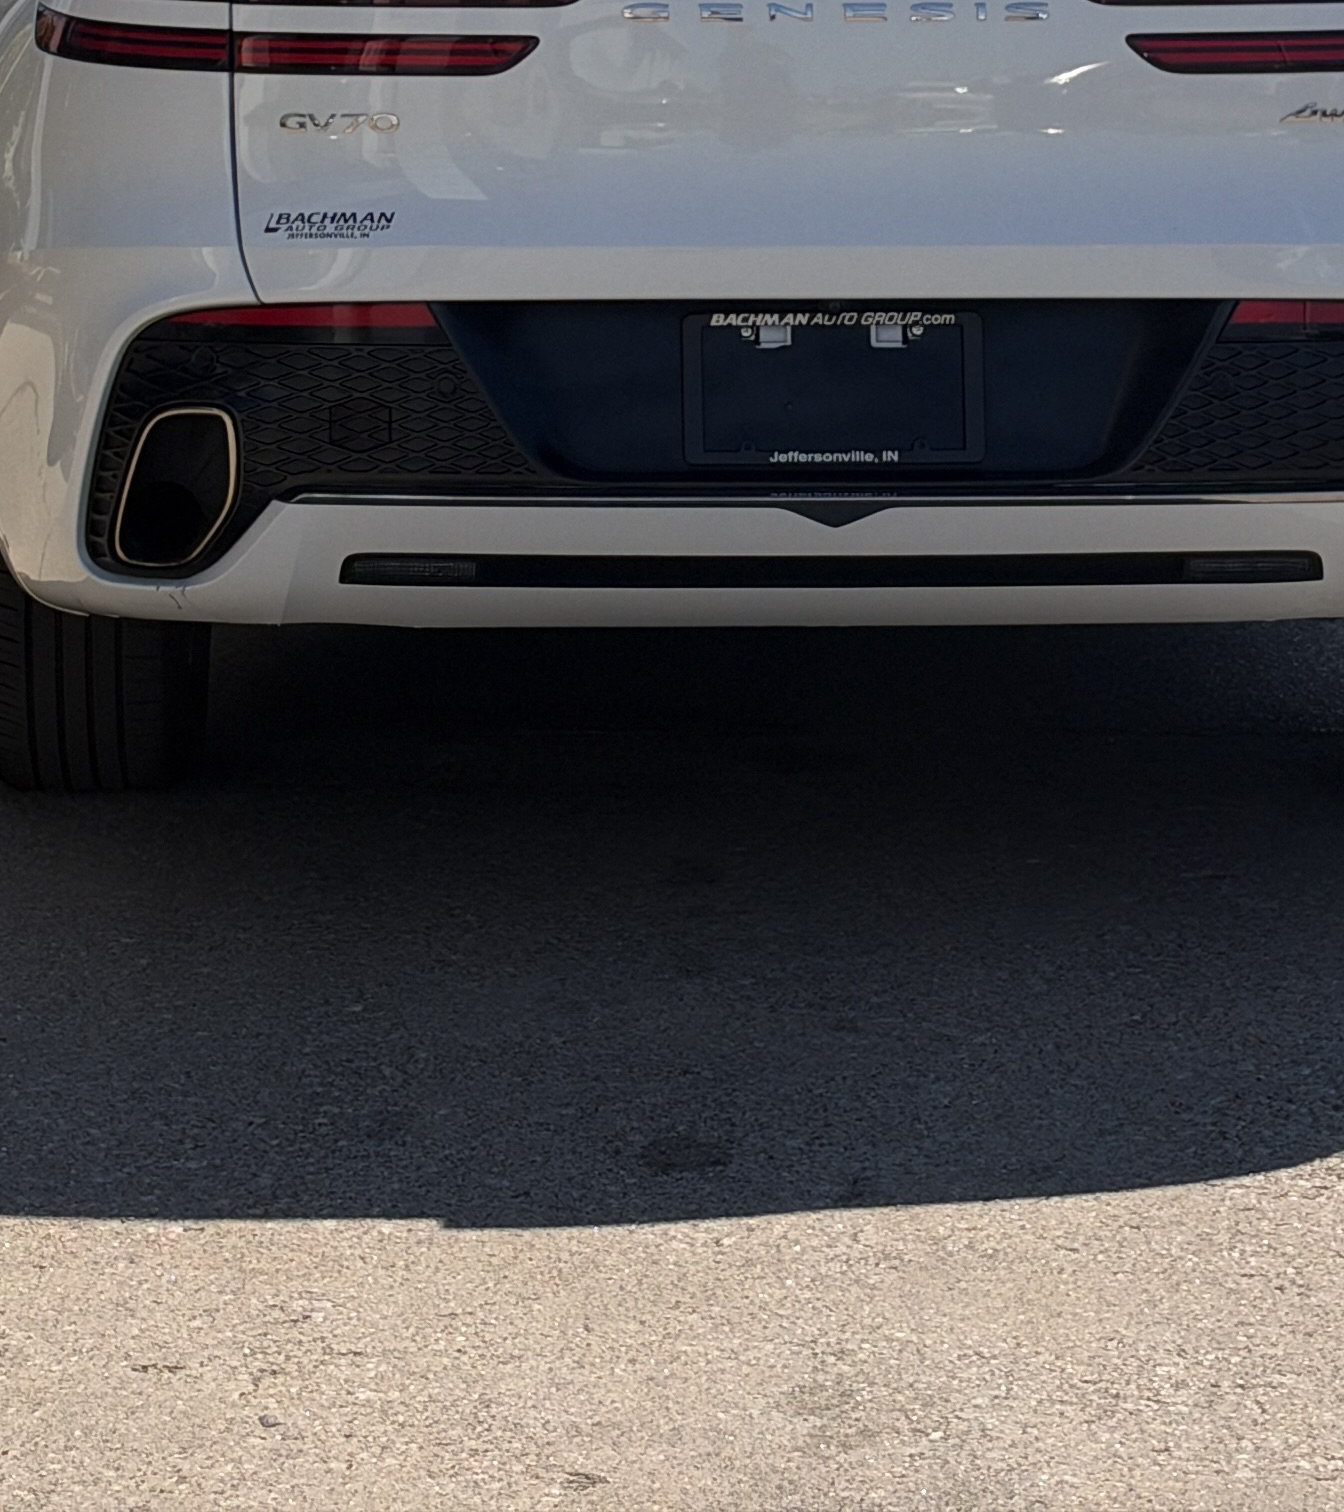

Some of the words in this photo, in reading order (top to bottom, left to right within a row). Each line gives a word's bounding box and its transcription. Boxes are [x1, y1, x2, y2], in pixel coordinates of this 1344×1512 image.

[621, 1, 1050, 23] GENESIS
[278, 110, 401, 136] GV70
[275, 211, 396, 226] BACHMAN
[284, 224, 328, 232] AUTO
[334, 224, 391, 232] GROUP
[709, 312, 809, 327] BACHMAN
[860, 311, 956, 326] GROUP.com
[769, 450, 879, 464] Jeffersonville,
[882, 450, 899, 463] IN
